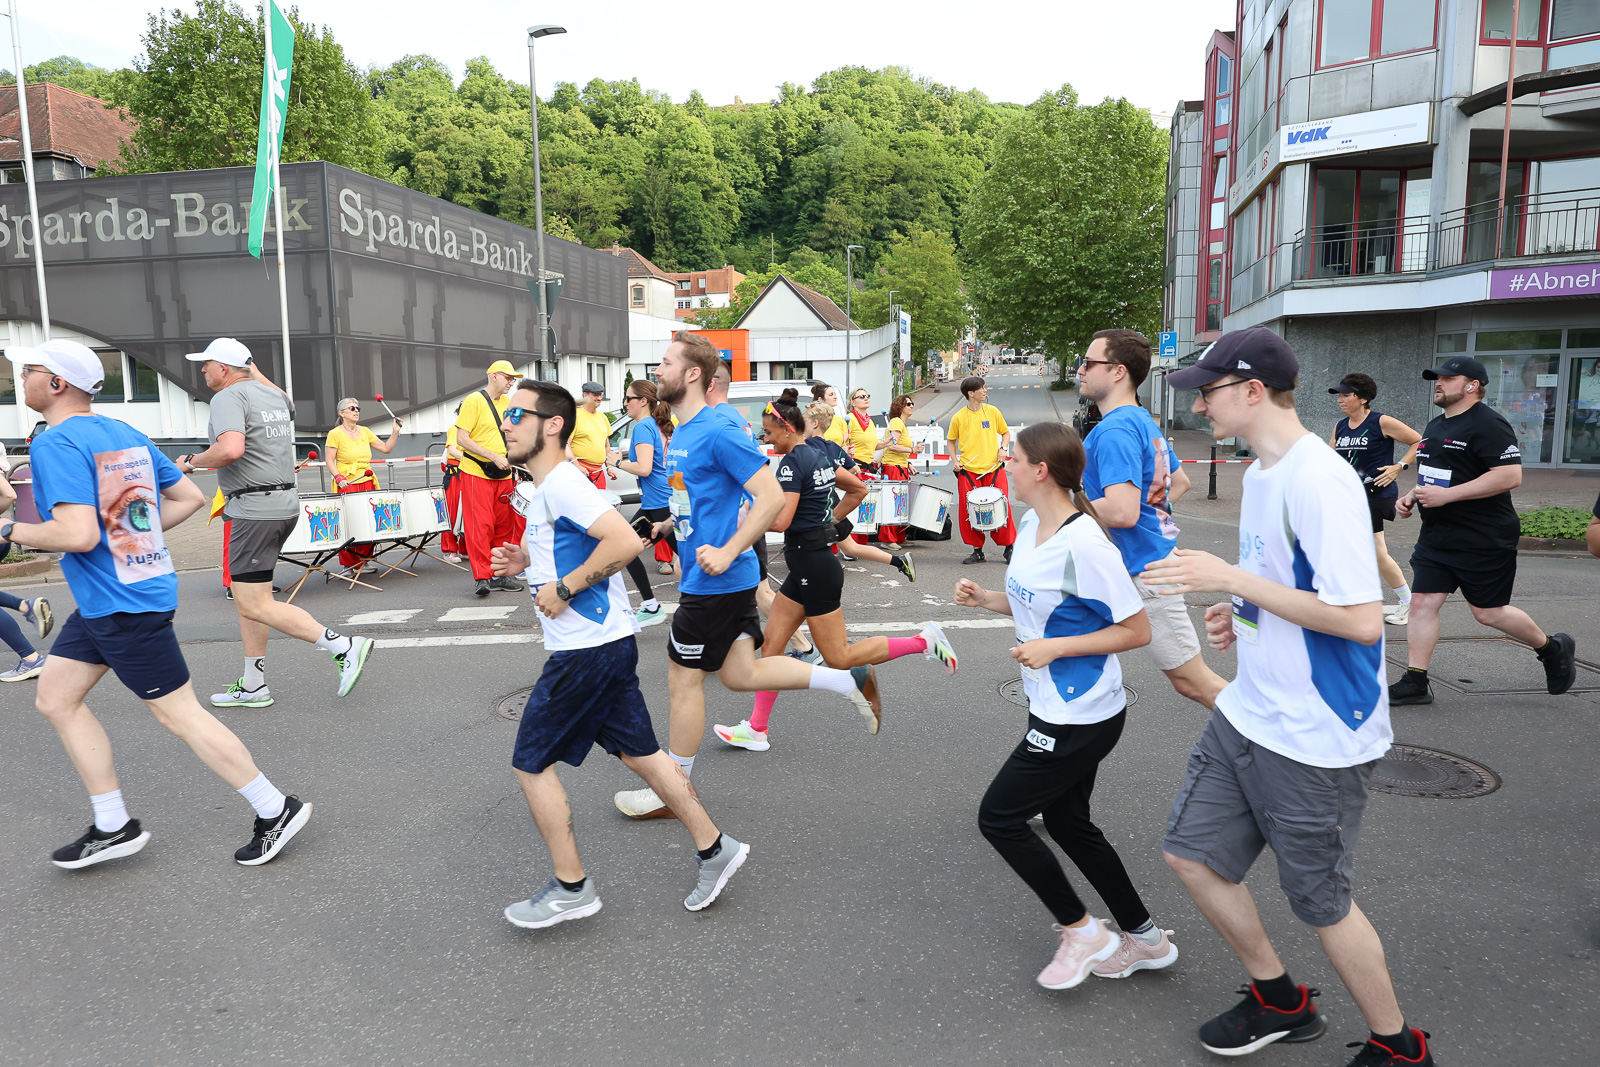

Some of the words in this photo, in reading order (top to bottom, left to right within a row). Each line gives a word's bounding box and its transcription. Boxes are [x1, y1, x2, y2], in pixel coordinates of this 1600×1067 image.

[1288, 126, 1331, 145] VdK
[339, 188, 534, 277] Sparda-Bank
[1163, 334, 1170, 344] P
[1008, 576, 1035, 604] COMET
